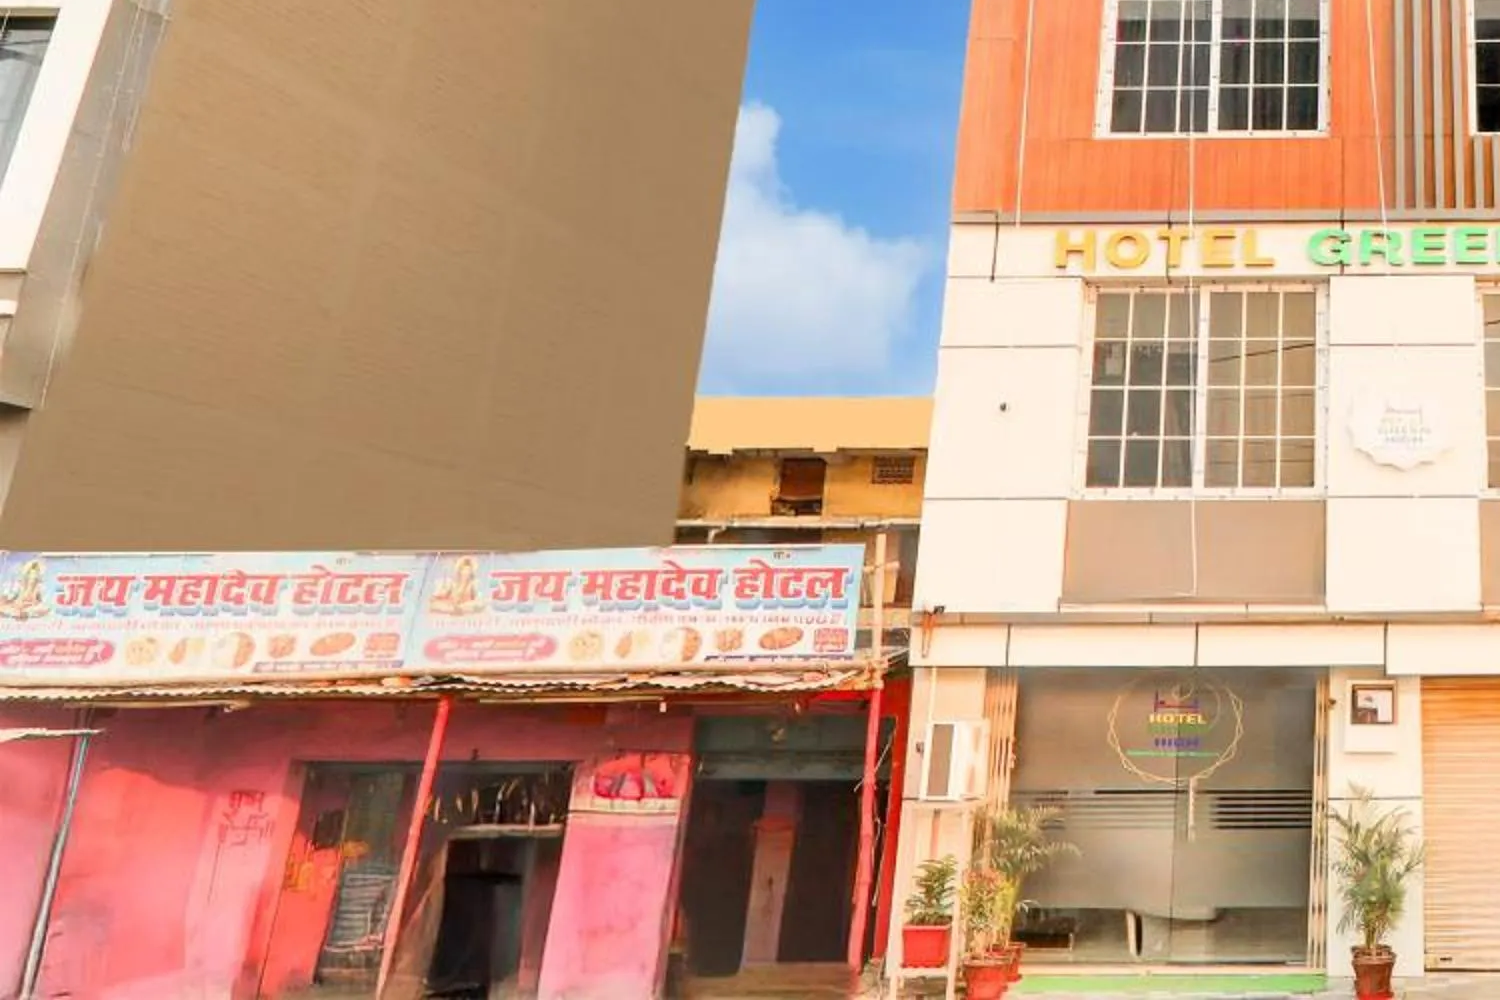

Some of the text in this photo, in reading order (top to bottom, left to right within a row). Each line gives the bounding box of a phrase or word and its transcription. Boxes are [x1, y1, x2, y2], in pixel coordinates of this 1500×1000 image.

[1053, 229, 1275, 270] HOTEL
[56, 564, 410, 606] जय महादेव होटल
[490, 559, 849, 602] जय महादेव होटल
[1149, 713, 1207, 725] HOTEL
